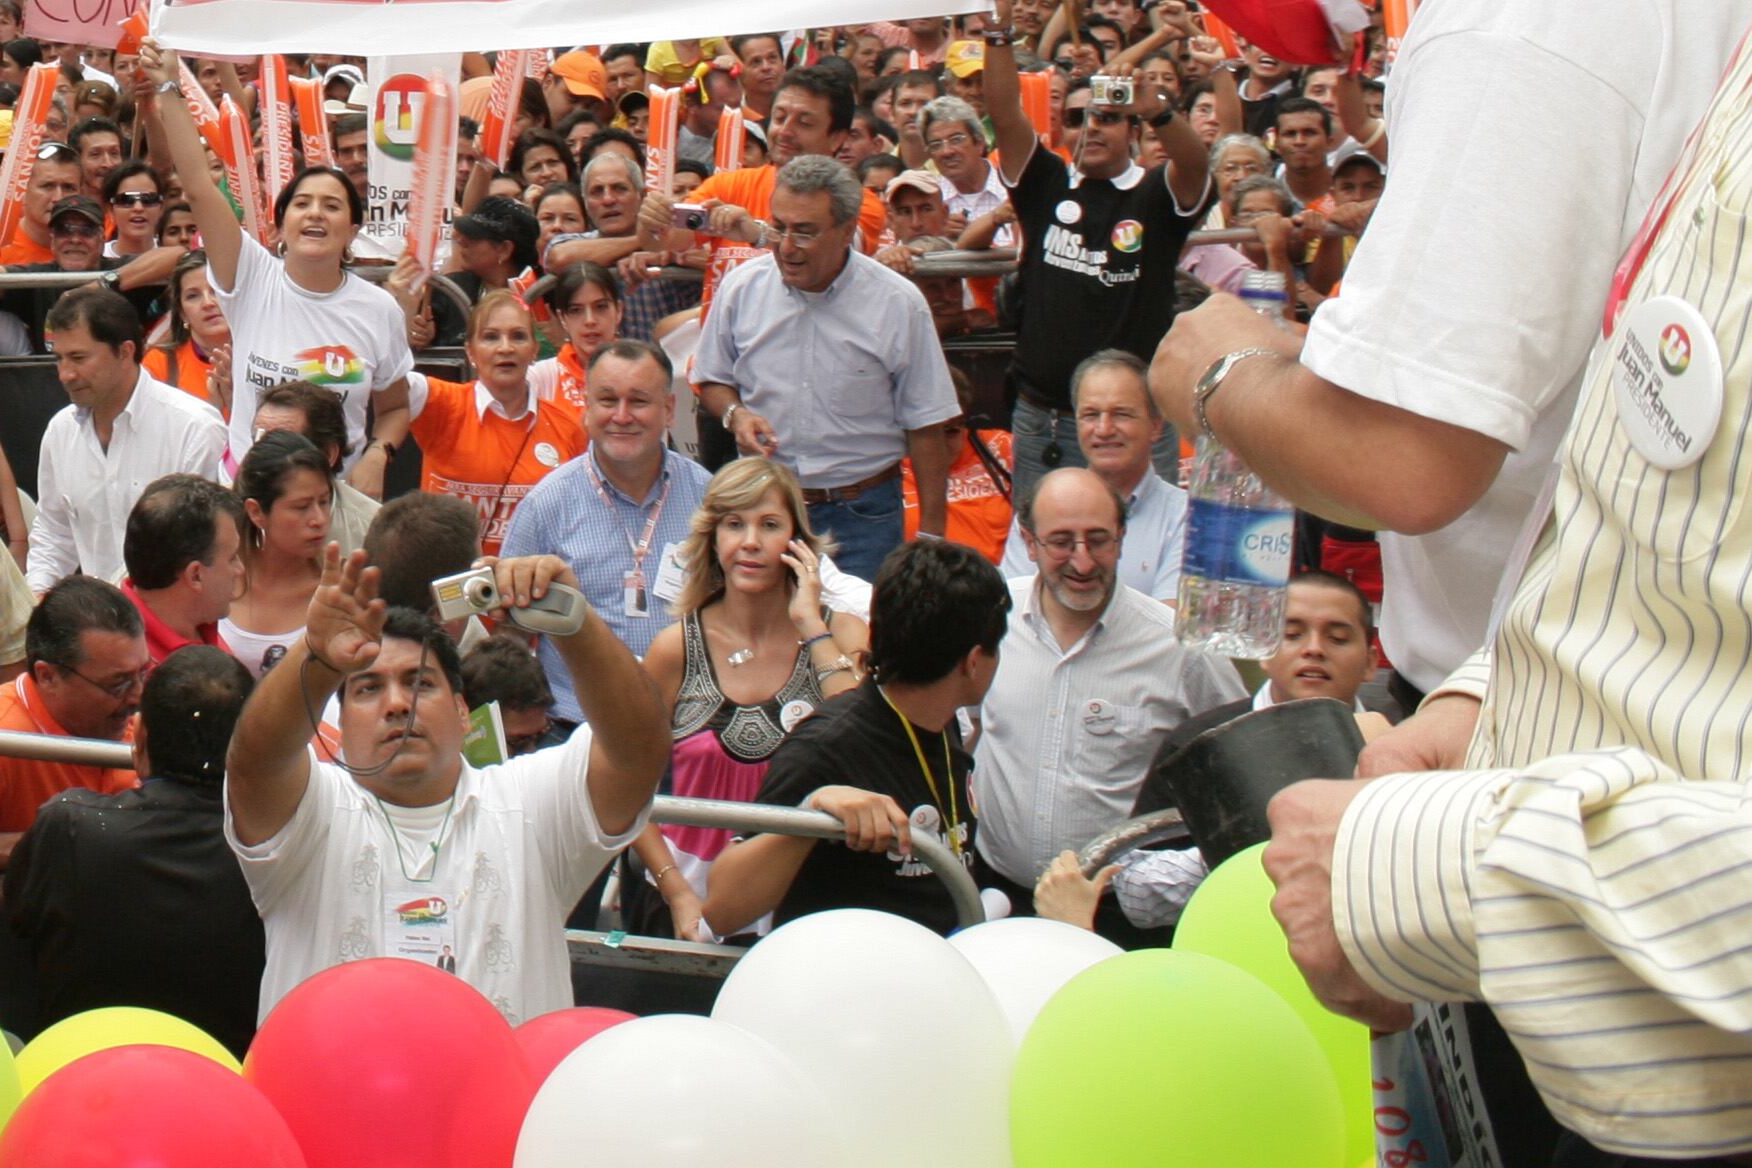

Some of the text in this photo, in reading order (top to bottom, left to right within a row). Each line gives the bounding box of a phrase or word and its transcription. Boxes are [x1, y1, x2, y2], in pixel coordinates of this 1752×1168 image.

[14, 122, 48, 203] SANTOS
[281, 366, 299, 377] con
[1625, 327, 1654, 373] UNIDOS
[1617, 341, 1693, 454] Juan Manuel
[1622, 373, 1675, 450] PRESIDENTE
[1244, 532, 1290, 555] CRIS
